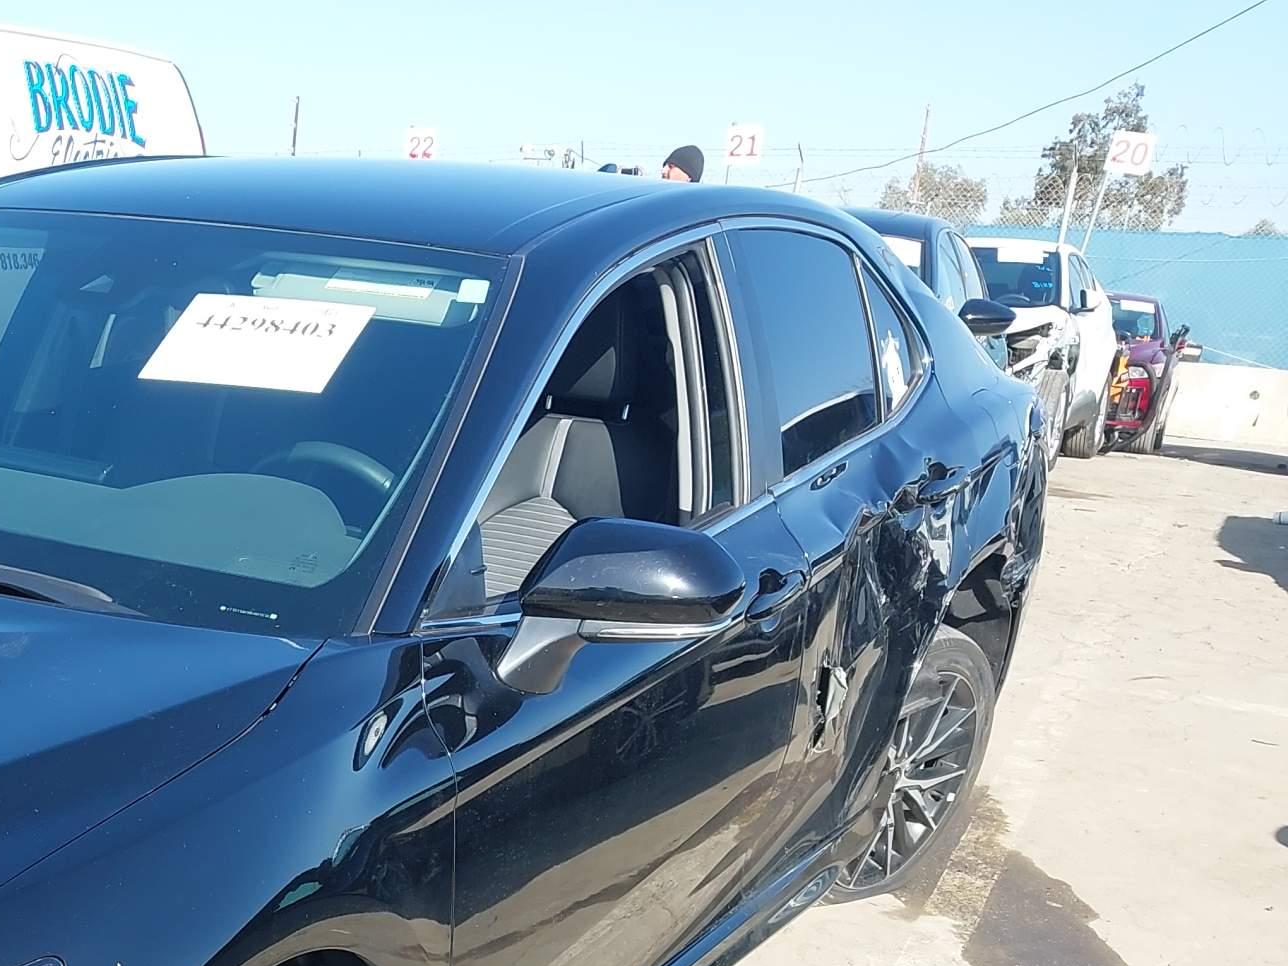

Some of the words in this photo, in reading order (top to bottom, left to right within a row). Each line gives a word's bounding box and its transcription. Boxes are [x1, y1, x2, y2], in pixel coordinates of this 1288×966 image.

[23, 59, 146, 149] BRODIE
[409, 135, 434, 159] 22
[730, 134, 758, 157] 21
[1110, 139, 1149, 167] 20
